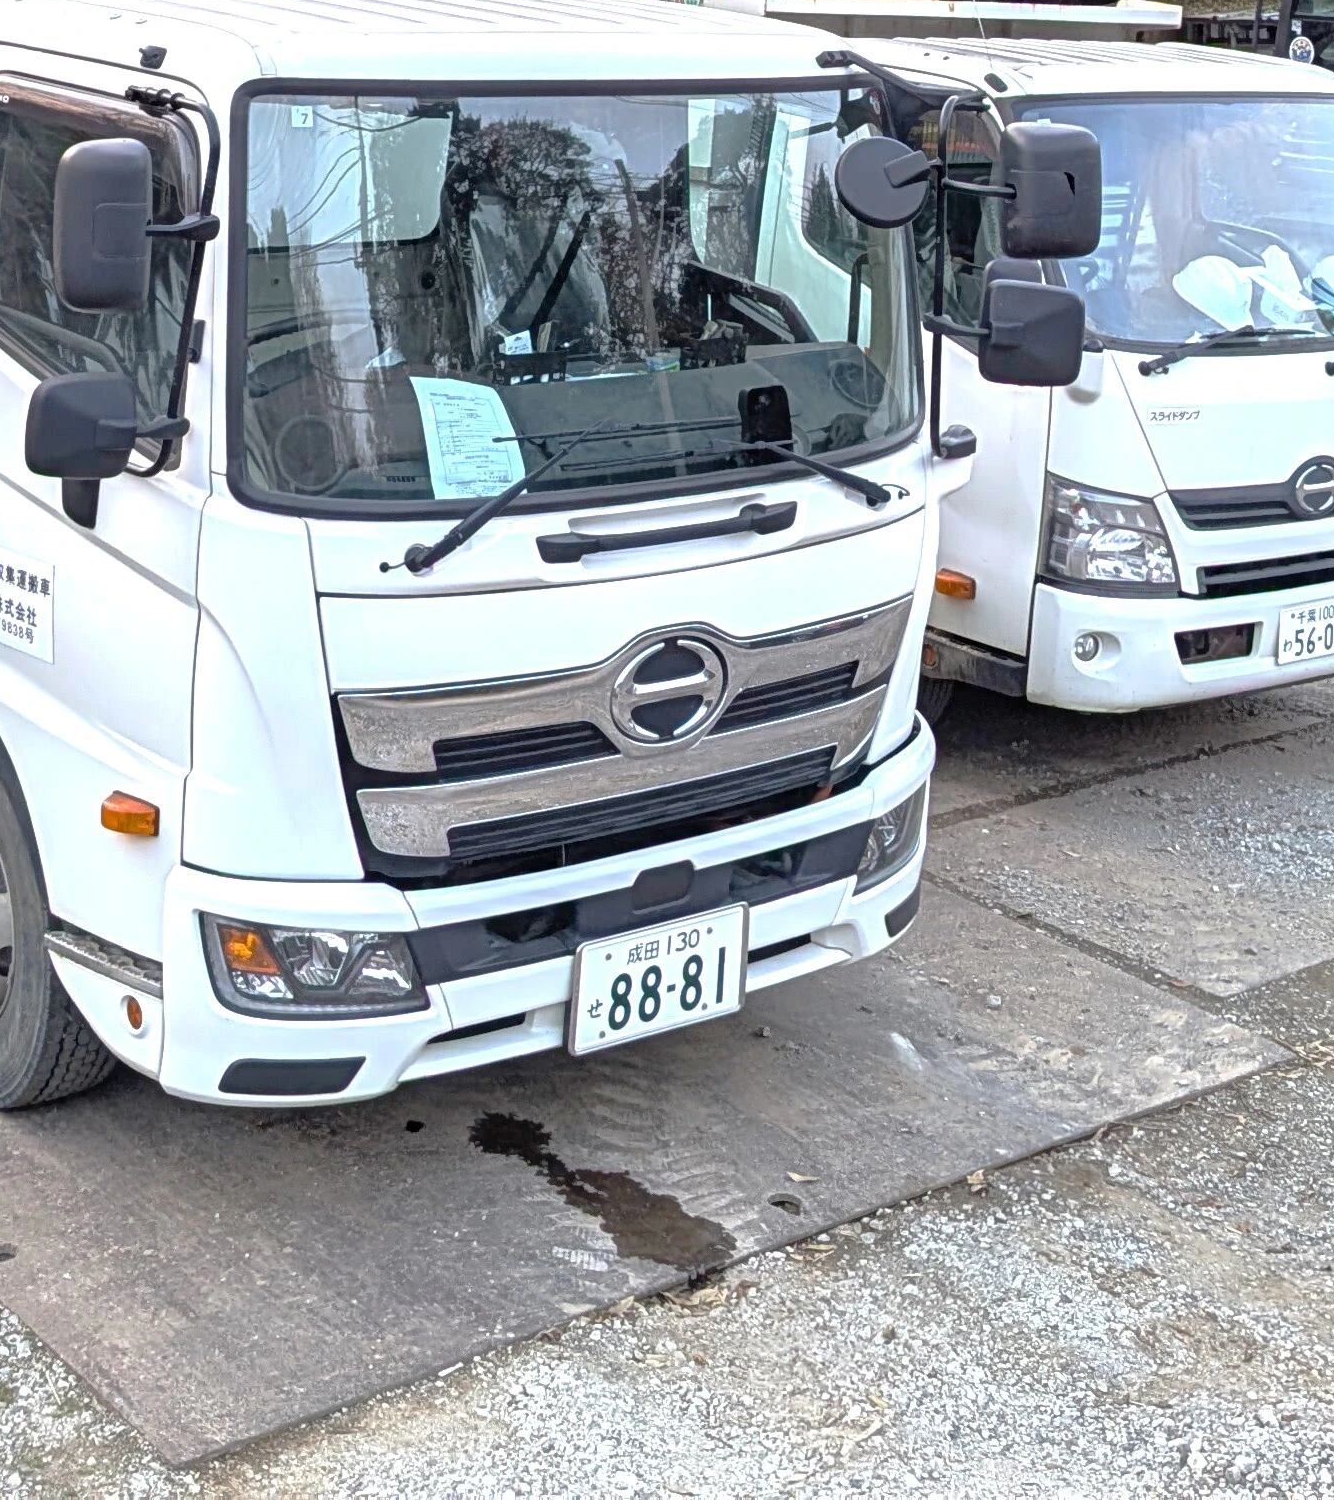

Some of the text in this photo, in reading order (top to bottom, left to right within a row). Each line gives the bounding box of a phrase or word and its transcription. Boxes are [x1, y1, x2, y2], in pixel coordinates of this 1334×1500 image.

[301, 112, 308, 124] 7
[1149, 409, 1201, 422] スライドダンプ
[1297, 604, 1334, 624] 千葉 100
[626, 928, 700, 965] 成田 130
[586, 946, 727, 1031] せ 88-81
